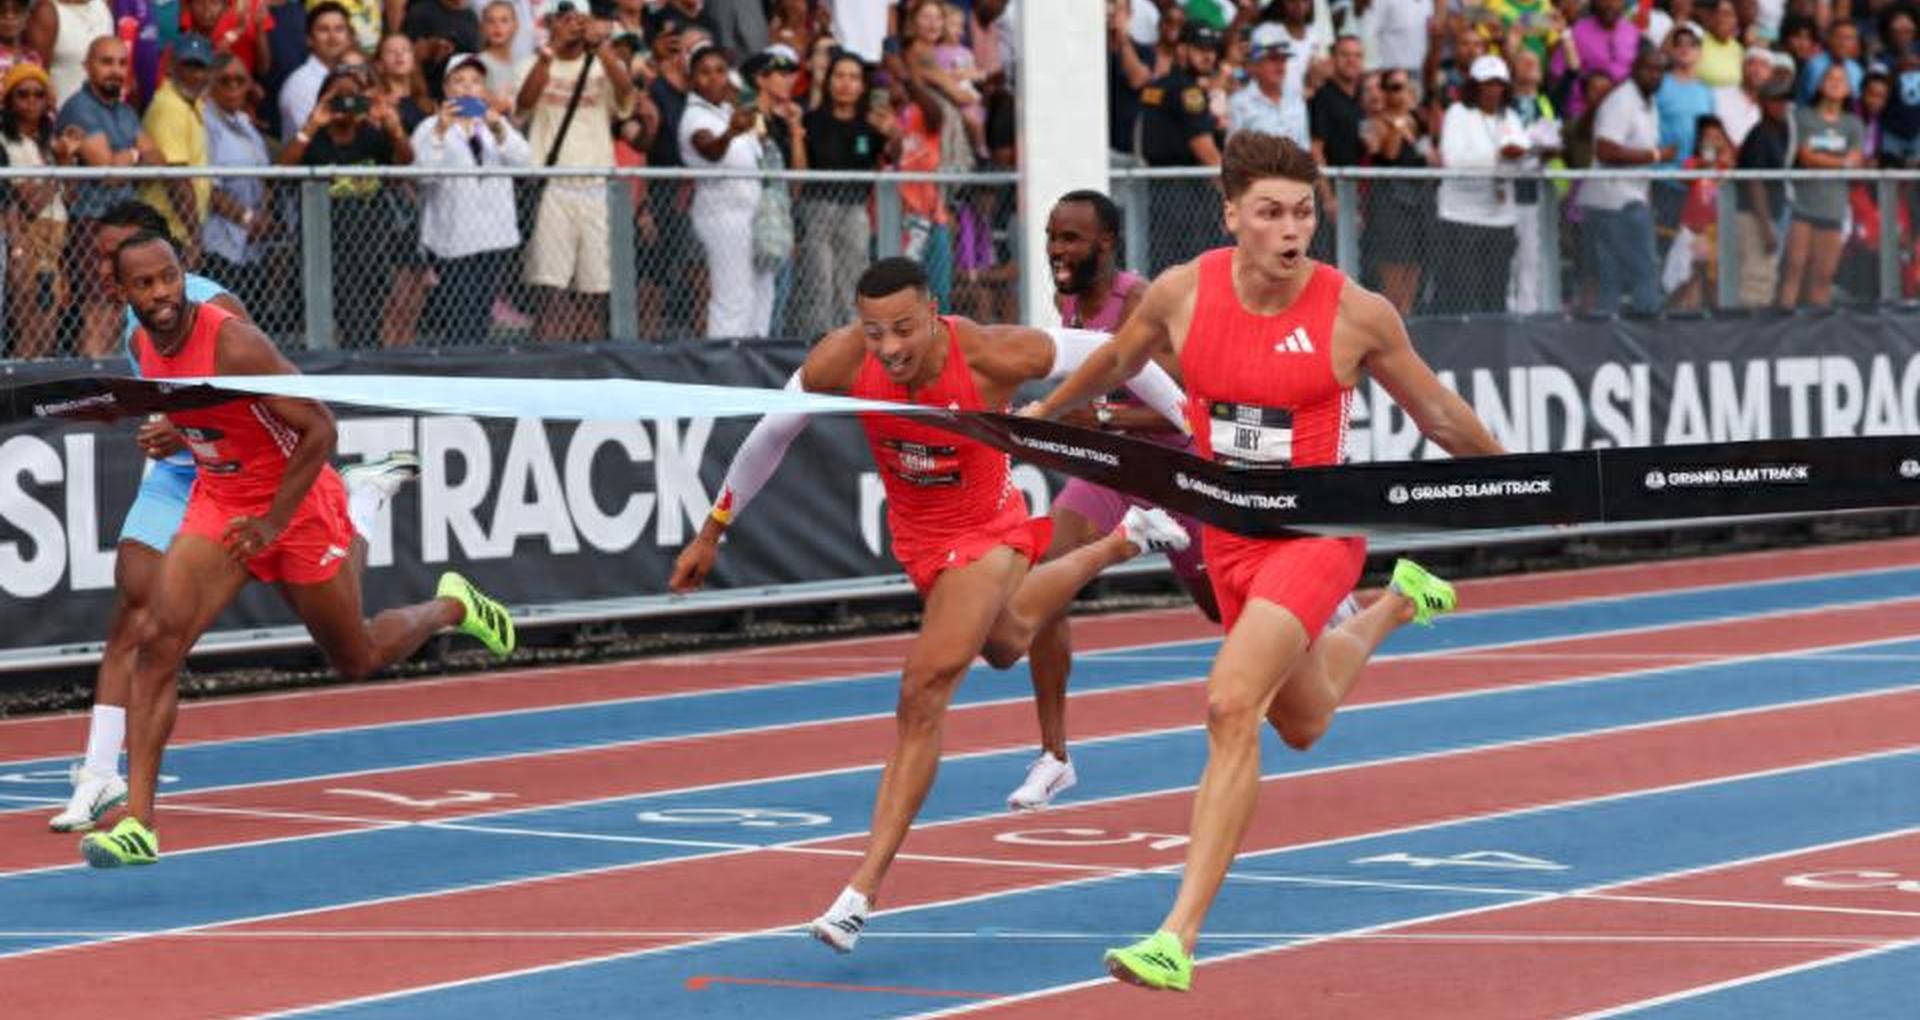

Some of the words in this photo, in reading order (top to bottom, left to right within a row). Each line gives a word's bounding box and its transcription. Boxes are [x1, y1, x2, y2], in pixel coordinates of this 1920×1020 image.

[1668, 471, 1721, 486] GRAND
[1722, 468, 1758, 482] SLAM
[1760, 465, 1808, 480] TRACK
[338, 415, 727, 568] TRACK
[1411, 484, 1463, 500] GRAND
[1464, 480, 1502, 496] SLAM
[1502, 479, 1550, 494] TRACK
[1250, 494, 1297, 509] TRACK
